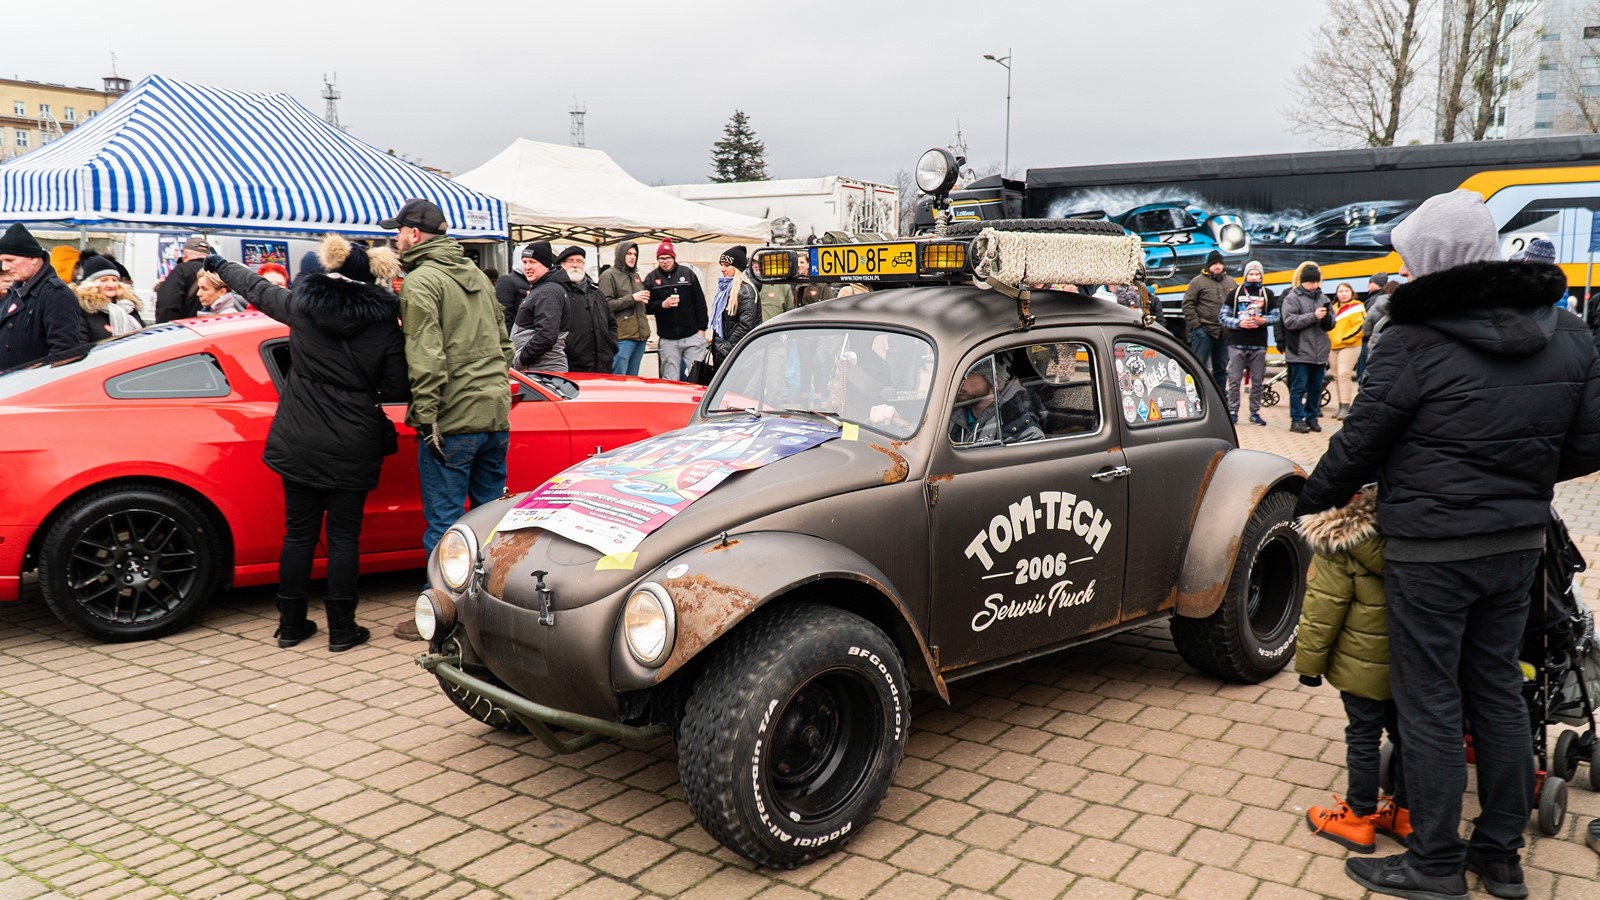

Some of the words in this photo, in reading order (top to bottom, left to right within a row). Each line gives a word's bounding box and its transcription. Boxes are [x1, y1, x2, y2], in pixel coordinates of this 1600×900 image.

[1162, 232, 1193, 245] 23
[811, 265, 819, 273] PL
[821, 249, 859, 274] GND
[866, 247, 889, 273] 8F
[964, 491, 1112, 571] TOM-TECH
[1015, 552, 1067, 585] 2006
[971, 593, 1047, 632] Serwis
[1044, 579, 1096, 617] Truck
[1258, 624, 1299, 658] Goodrich
[848, 646, 902, 741] BFGoodrich
[758, 698, 780, 734] T/A
[751, 739, 793, 843] All-Terrain
[793, 821, 852, 848] Radial
